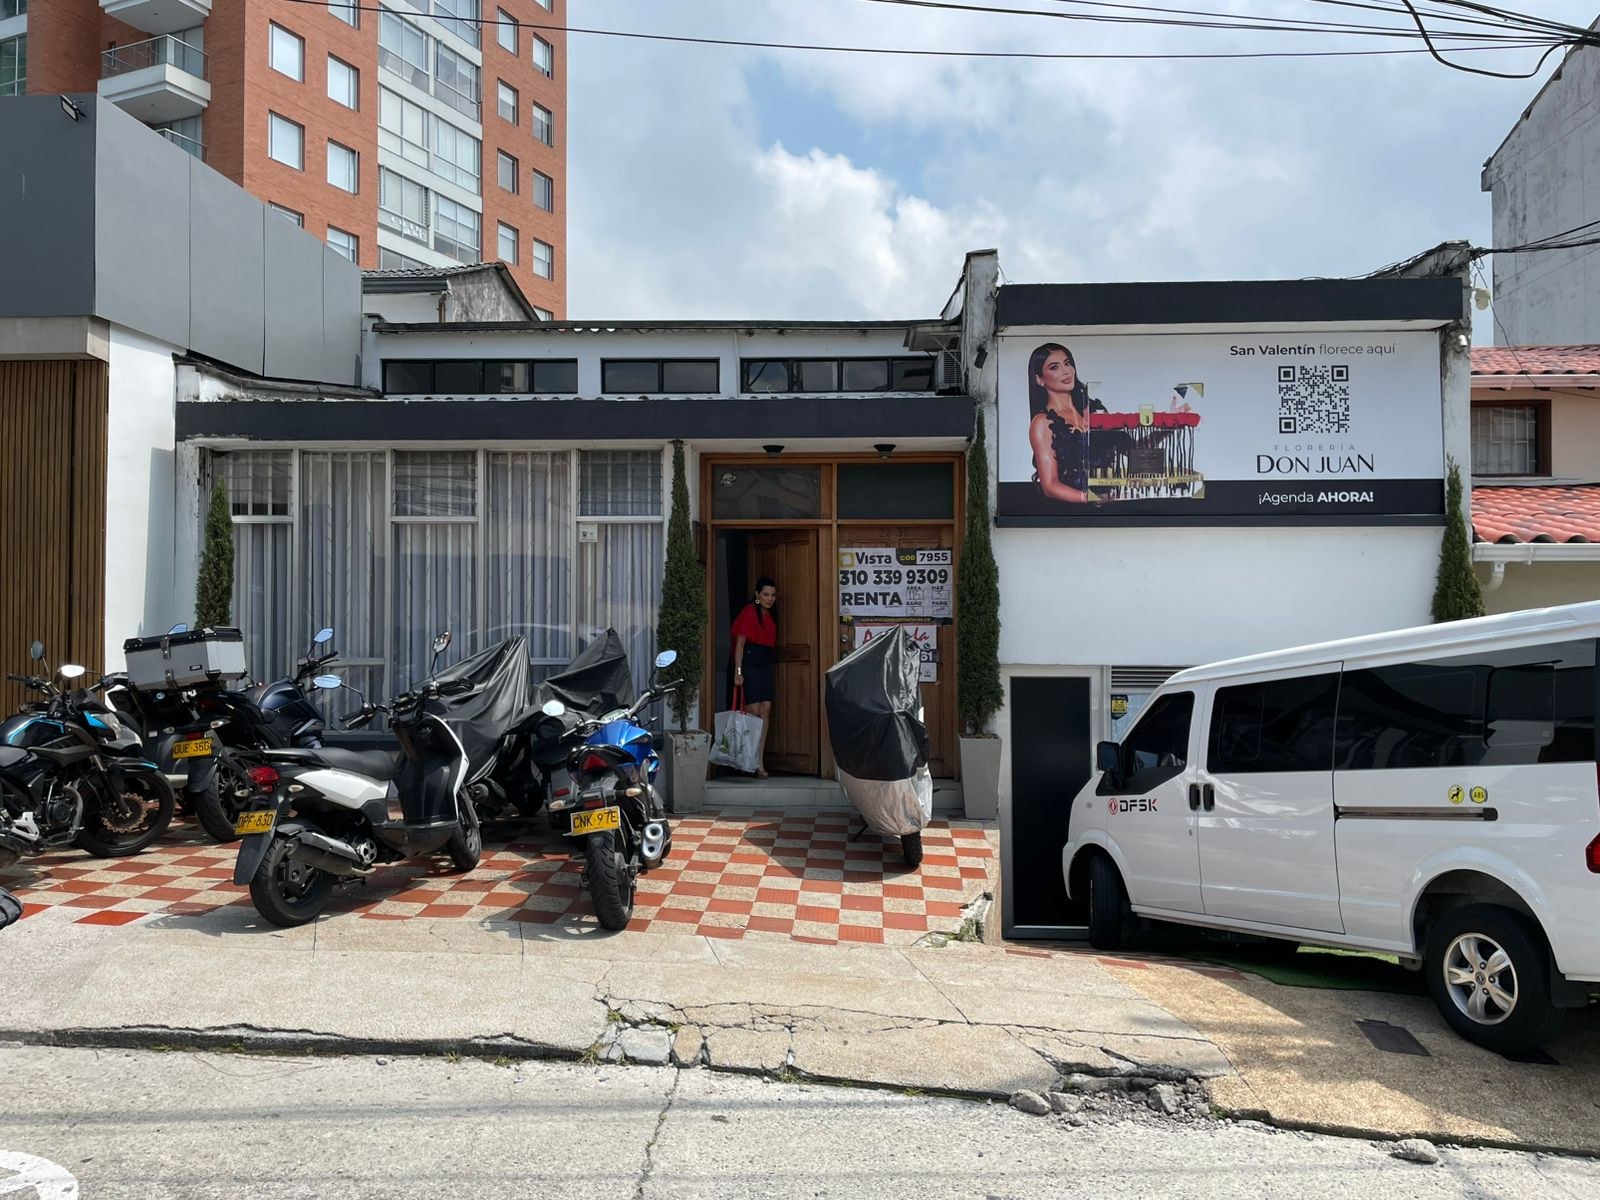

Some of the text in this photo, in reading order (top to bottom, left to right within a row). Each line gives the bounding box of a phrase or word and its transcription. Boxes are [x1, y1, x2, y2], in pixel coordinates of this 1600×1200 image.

[1230, 343, 1396, 356] San Valentín florece aquí
[1274, 444, 1355, 452] FLORERÍA
[1256, 453, 1375, 474] DON JUAN
[1258, 491, 1374, 506] ¡Agenda AHORA!
[919, 552, 948, 562] 7955
[839, 568, 948, 586] 310 339 9309
[841, 592, 903, 606] RENTA
[1473, 791, 1485, 799] ABS
[1119, 799, 1158, 811] DFSK
[237, 812, 274, 828] DPF 83D
[573, 811, 618, 829] CNK 97E
